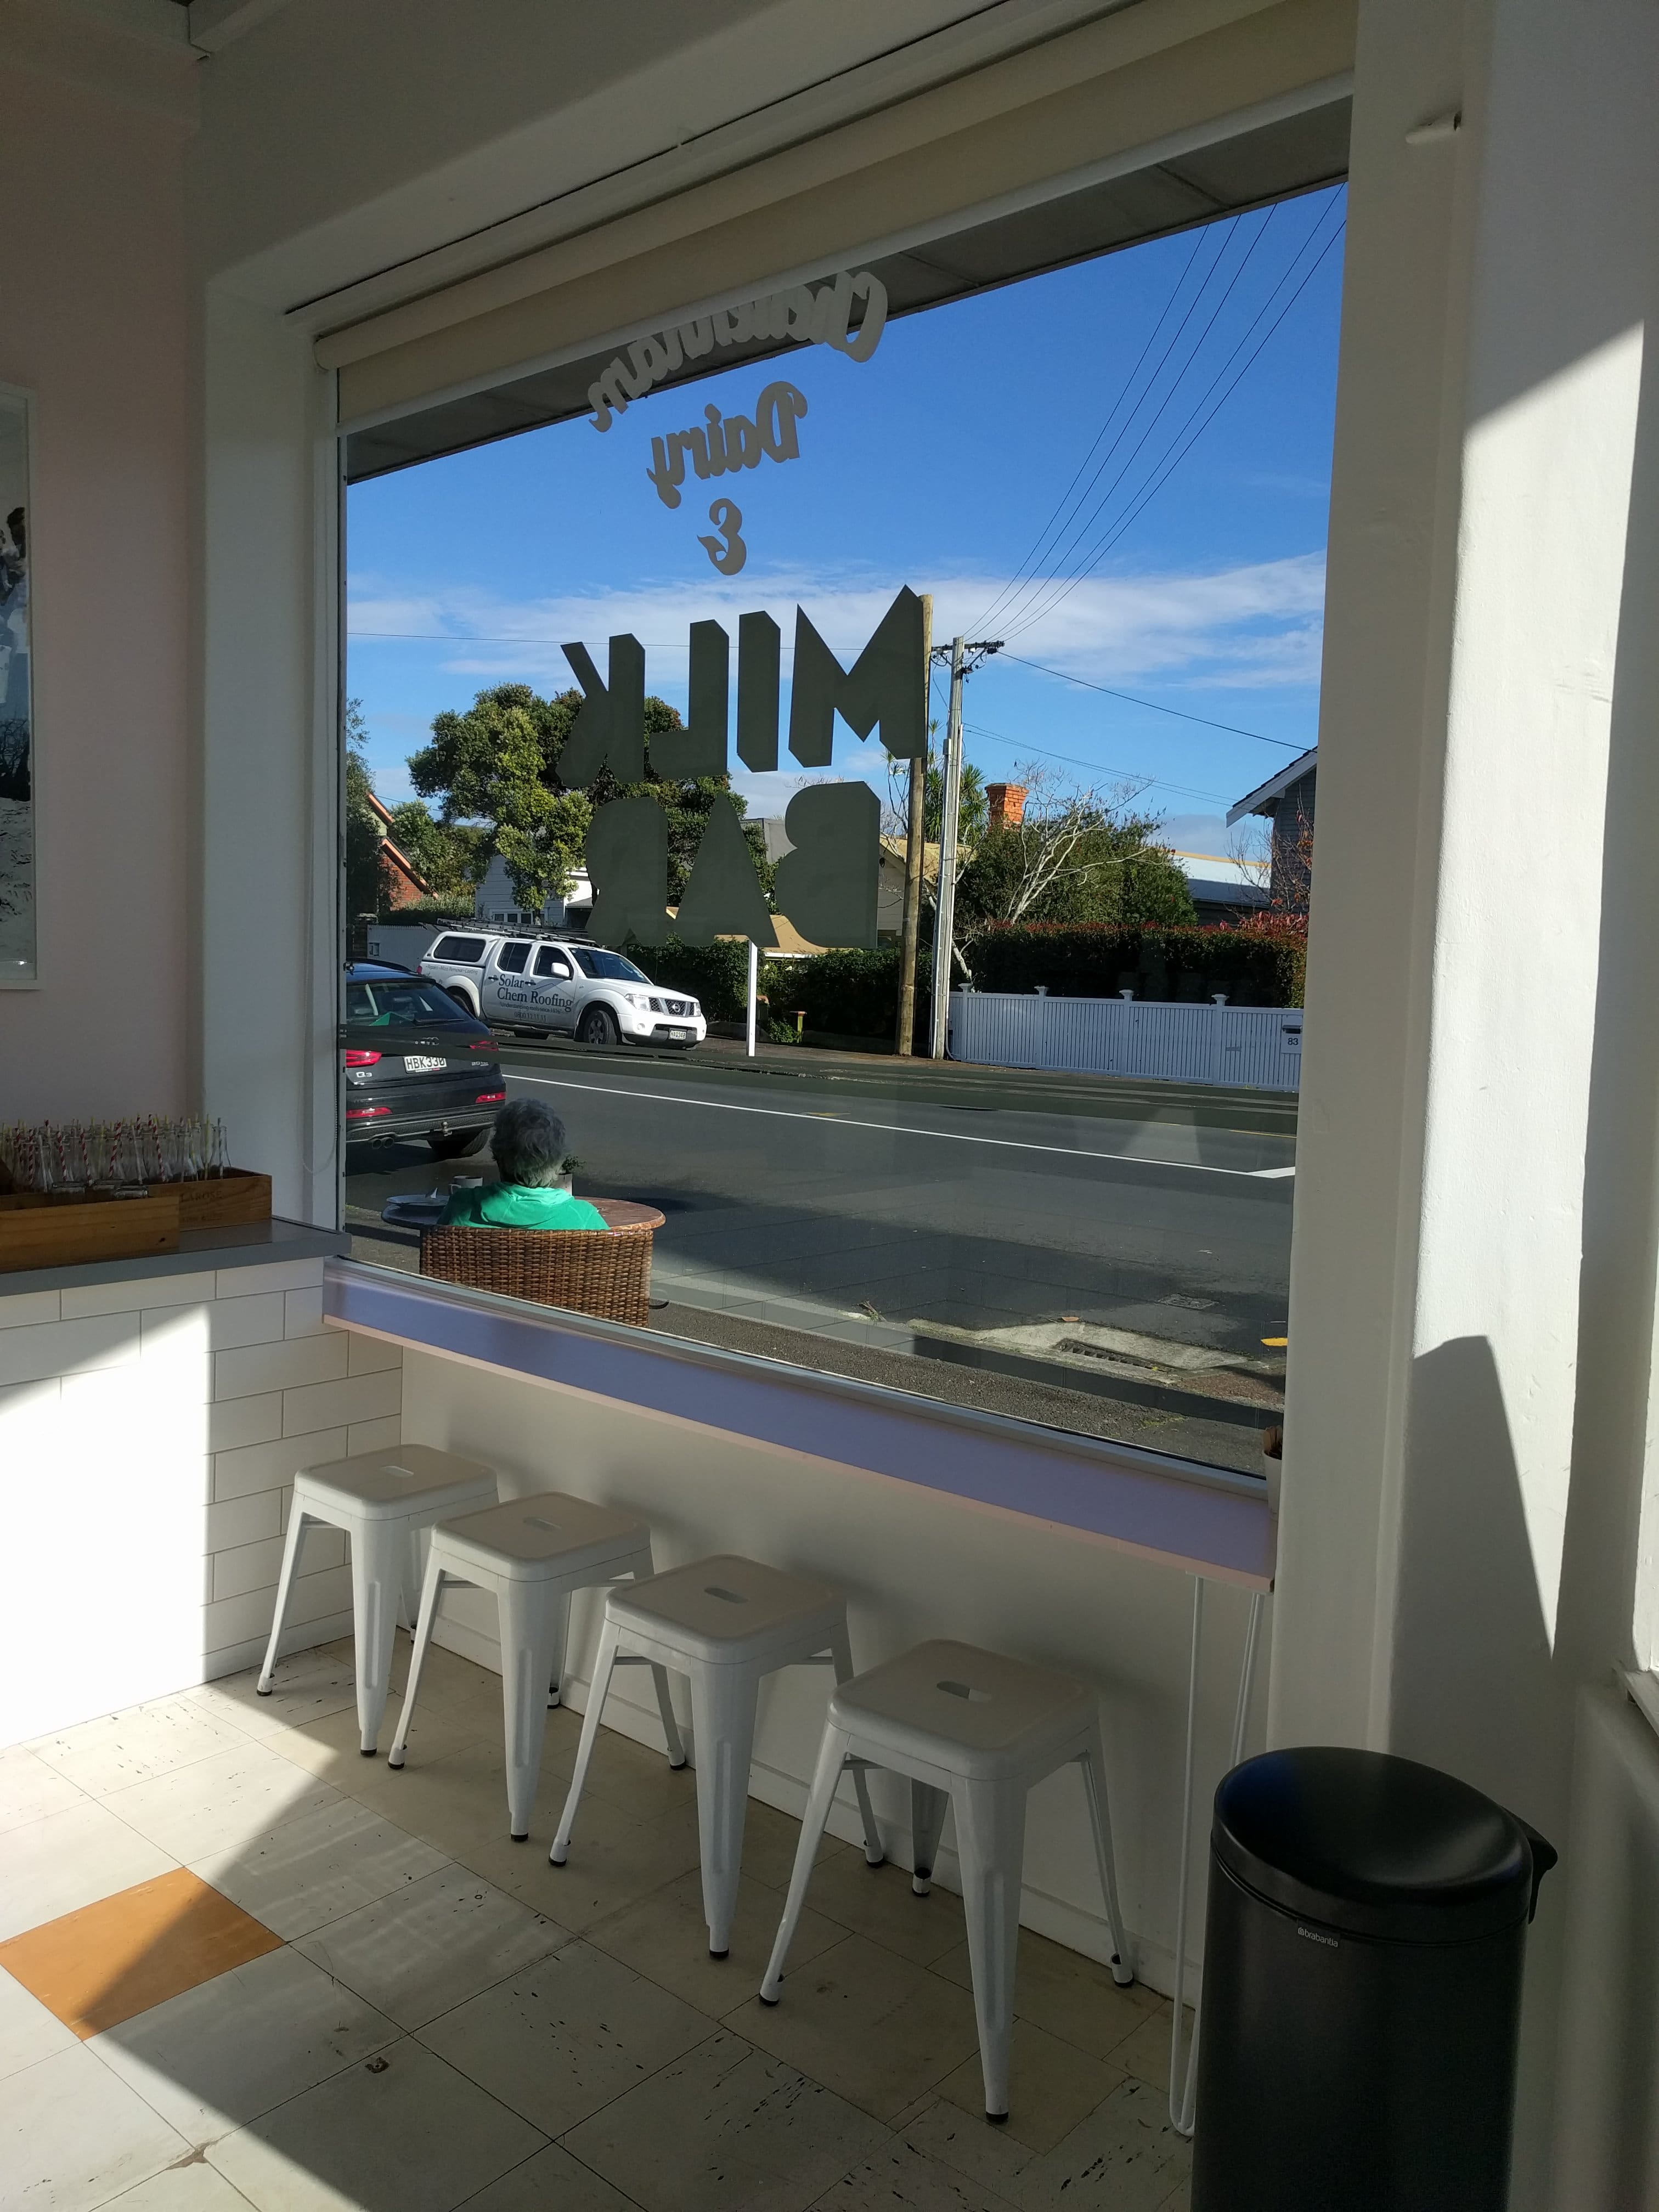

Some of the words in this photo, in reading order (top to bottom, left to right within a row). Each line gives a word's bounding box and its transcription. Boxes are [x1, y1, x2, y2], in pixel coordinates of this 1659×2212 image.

[499, 974, 524, 988] Solar
[497, 987, 527, 1002] Chem
[530, 991, 573, 1012] Roofing
[1305, 1928, 1339, 1948] brabantia
